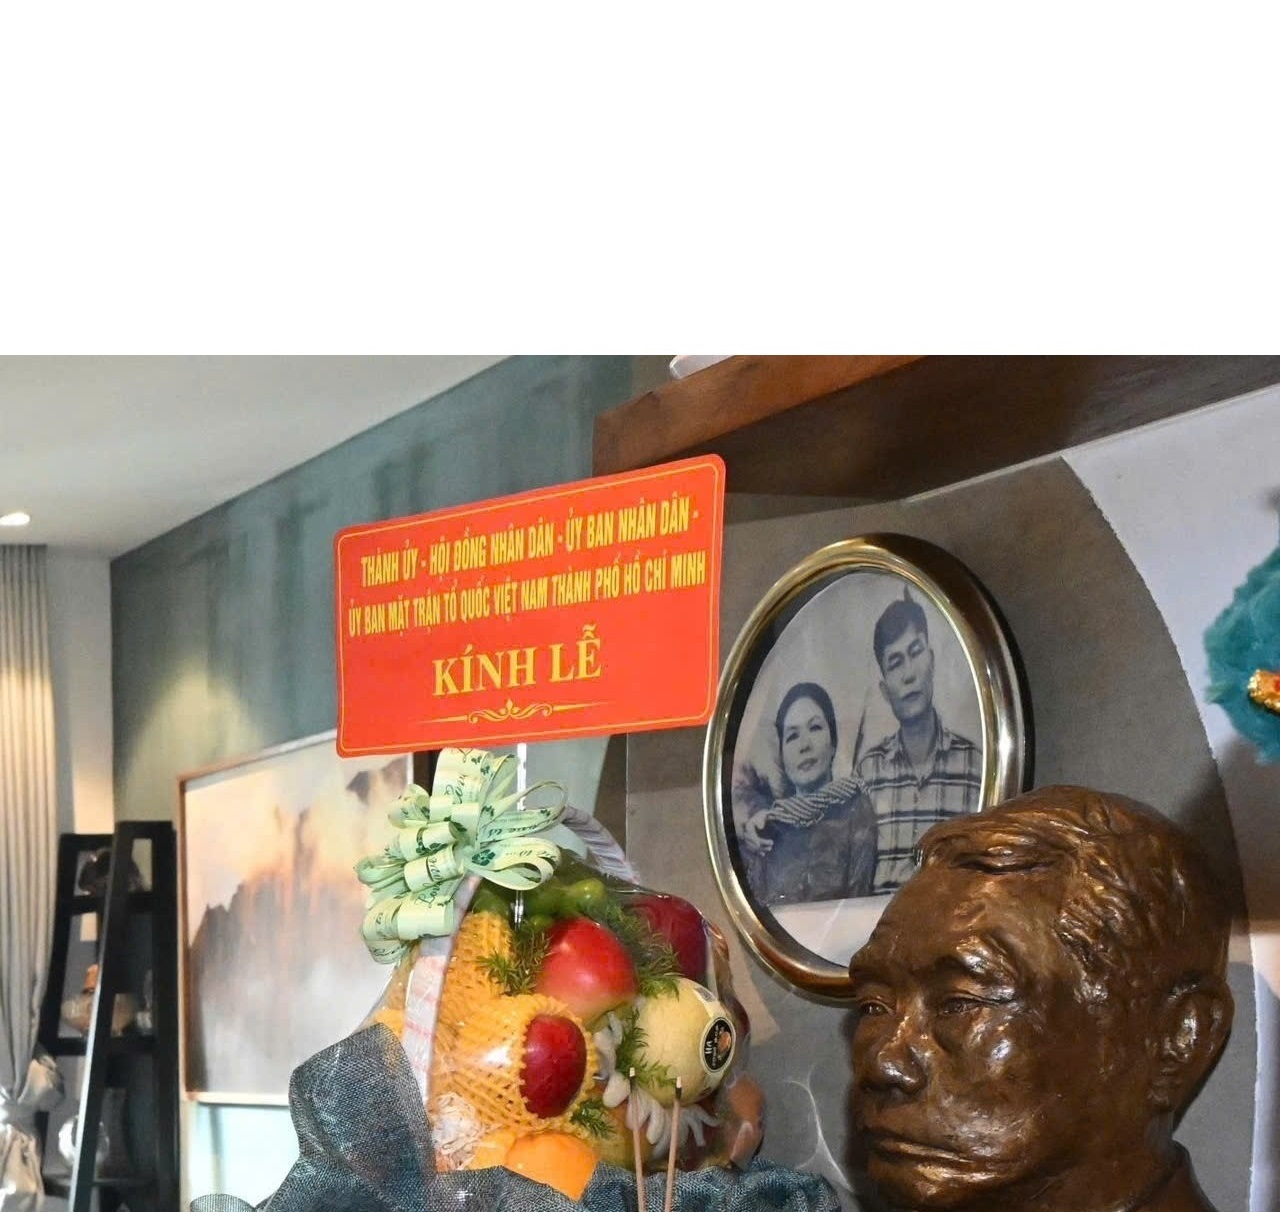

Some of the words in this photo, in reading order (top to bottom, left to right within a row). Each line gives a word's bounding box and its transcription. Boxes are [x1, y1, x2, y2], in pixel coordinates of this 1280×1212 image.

[361, 546, 399, 587] THÀNH
[403, 539, 418, 580] ỦY
[430, 535, 450, 582] HỘI
[453, 526, 486, 572] ĐỒNG
[490, 522, 524, 565] NHÂN
[528, 516, 554, 559] DÂN
[566, 507, 583, 552] ỦY
[587, 511, 614, 549] BAN
[618, 497, 656, 543] NHÂN
[660, 491, 690, 536] DÂN
[348, 598, 361, 637] ỦY
[364, 604, 385, 635] BAN
[388, 595, 410, 637] MẶT
[413, 587, 440, 633] TRẬN
[444, 578, 458, 623] TỔ
[461, 575, 490, 623] QUỐC
[494, 575, 518, 621] VIỆT
[521, 576, 548, 611] NAM
[551, 565, 591, 606] THÀNH
[594, 552, 620, 600] PHỐ
[623, 550, 641, 595] HỒ
[644, 549, 666, 592] CHÍ
[670, 550, 706, 589] MINH
[431, 643, 535, 697] KÍNH
[549, 623, 602, 683] LỄ
